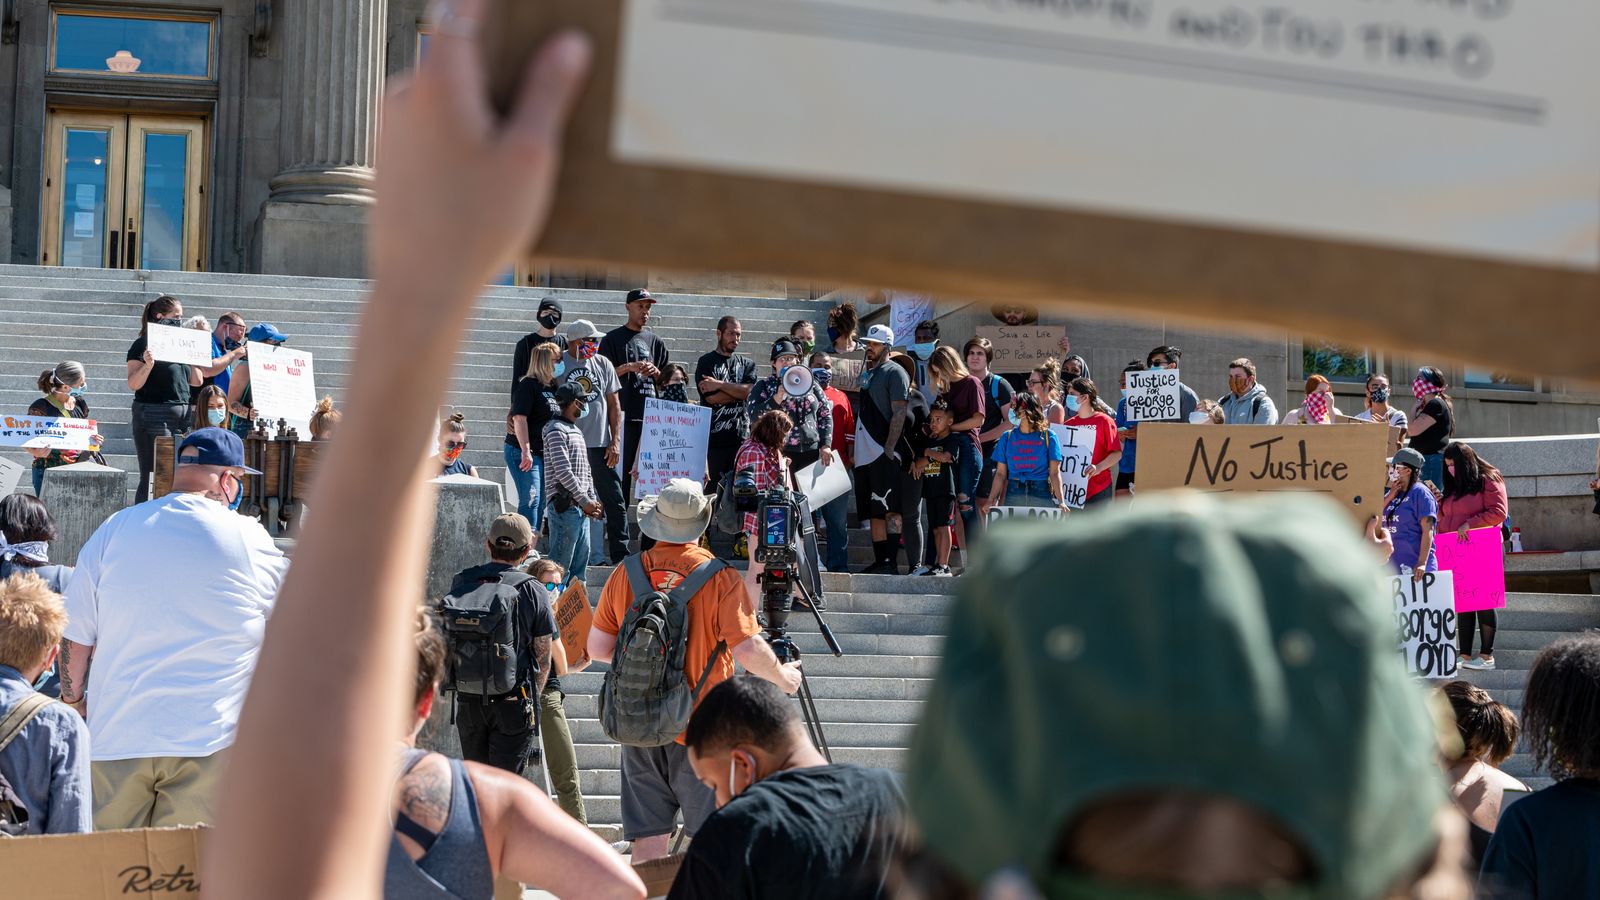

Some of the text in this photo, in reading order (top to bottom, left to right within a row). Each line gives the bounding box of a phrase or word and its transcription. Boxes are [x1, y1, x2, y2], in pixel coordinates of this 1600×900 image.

[998, 328, 1018, 339] Save
[1036, 330, 1052, 338] Life
[567, 369, 584, 383] AMILY
[1130, 373, 1176, 389] Justice
[1146, 387, 1160, 396] FOR
[1133, 406, 1176, 420] FLOYD
[1063, 427, 1079, 448] I
[1060, 454, 1089, 478] an't
[1184, 435, 1349, 486] No Justice
[1399, 642, 1457, 676] LOYD
[118, 865, 201, 894] Retr
